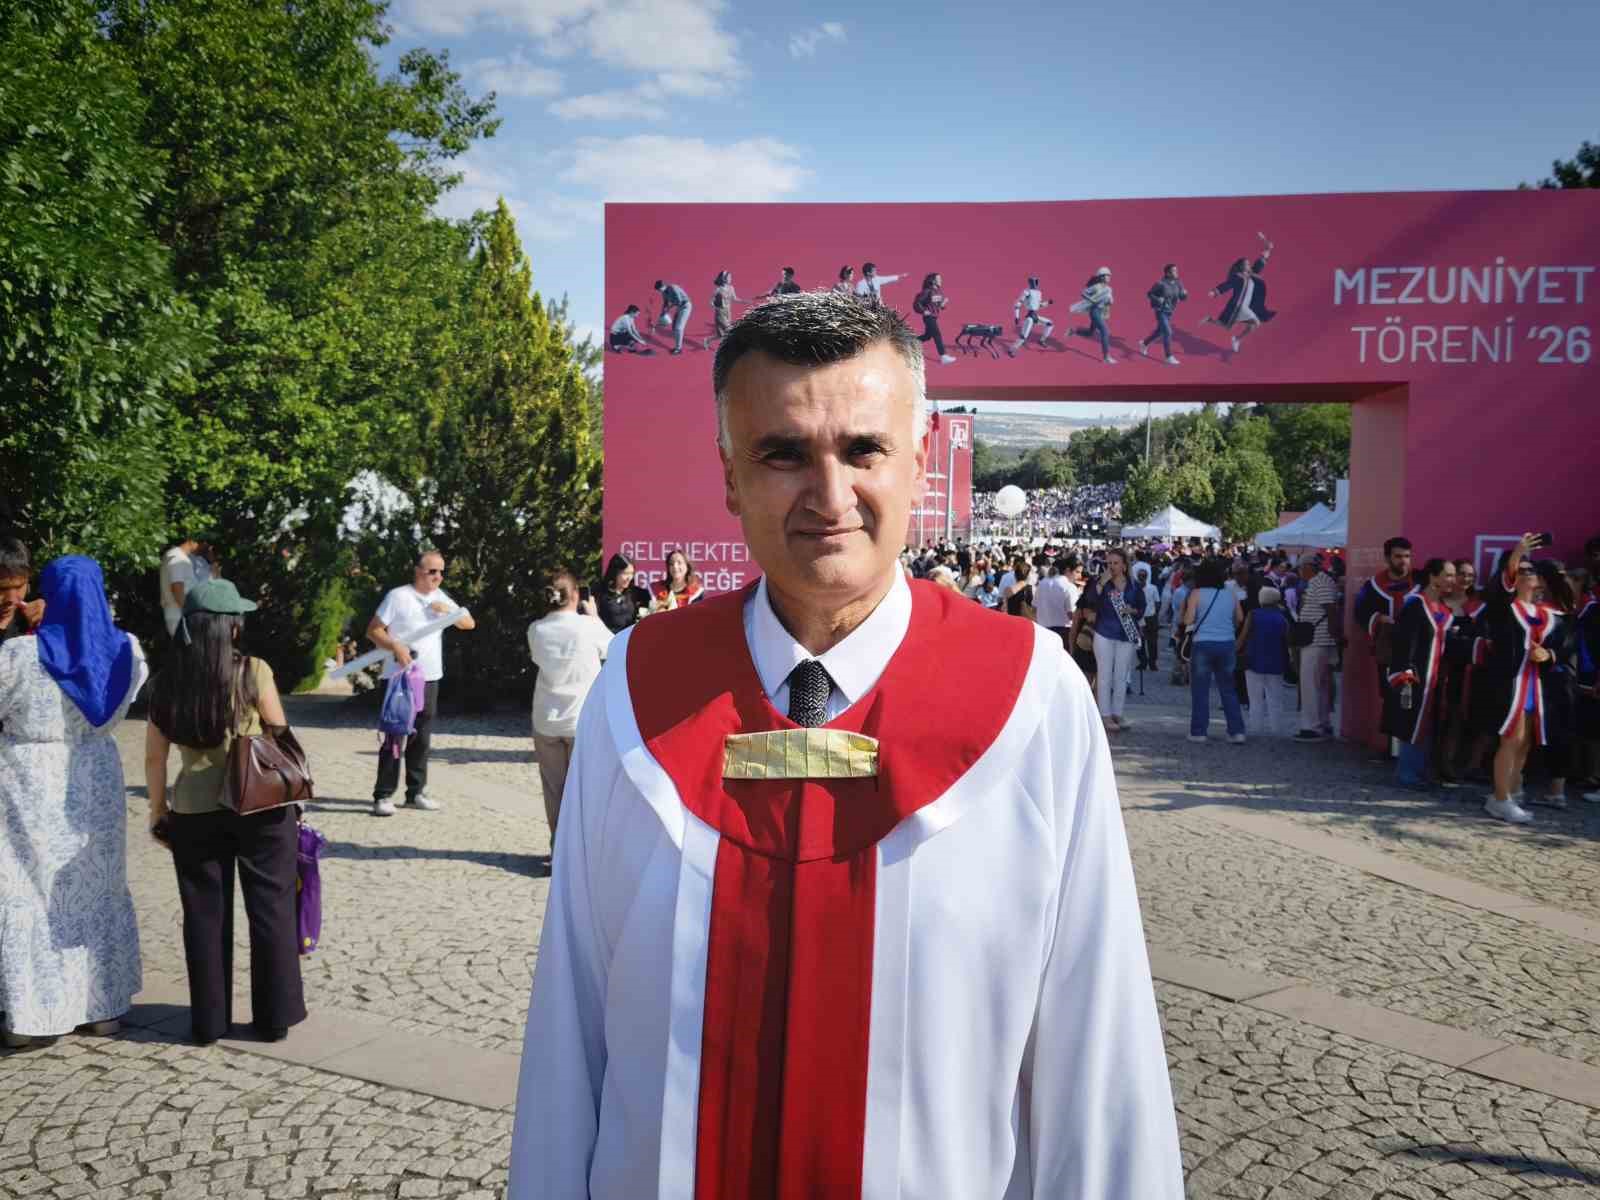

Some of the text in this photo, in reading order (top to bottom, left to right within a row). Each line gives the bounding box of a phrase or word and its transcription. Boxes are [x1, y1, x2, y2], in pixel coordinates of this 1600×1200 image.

[1333, 256, 1595, 305] MEZUNİYET
[1351, 316, 1515, 363] TÖRENİ
[634, 568, 745, 591] GEEĞE
